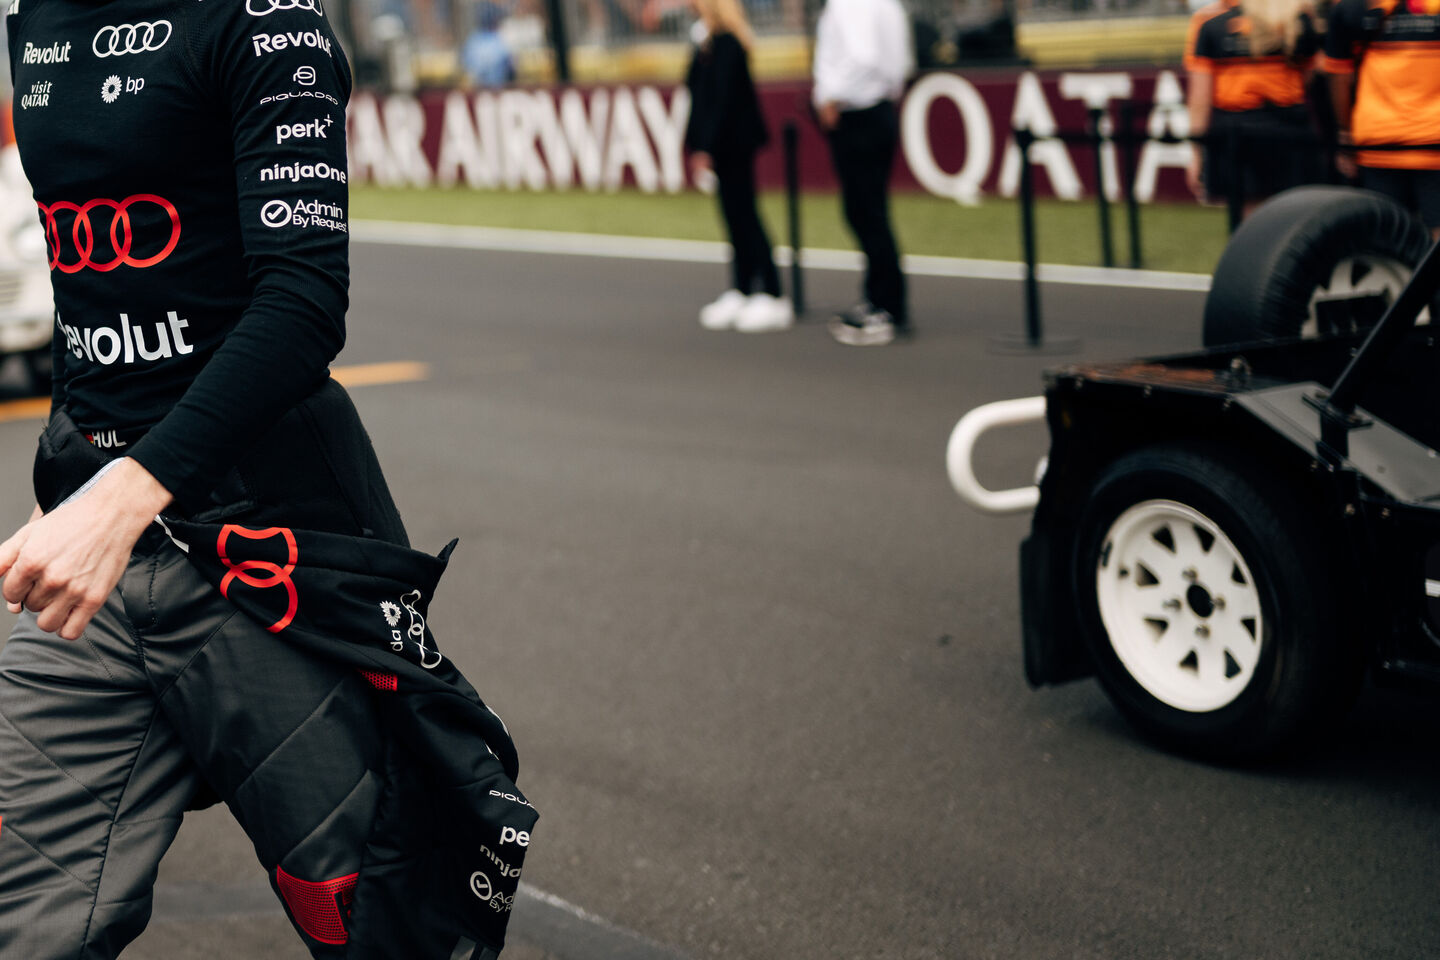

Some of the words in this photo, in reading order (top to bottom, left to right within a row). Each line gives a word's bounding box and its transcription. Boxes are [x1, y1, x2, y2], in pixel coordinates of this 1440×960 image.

[22, 41, 71, 64] Revolut
[31, 80, 53, 94] visit
[125, 76, 145, 95] bp
[21, 93, 50, 110] QATAR
[260, 91, 338, 105] PIQUADRO
[347, 93, 433, 189] AR
[436, 86, 691, 194] AIRWAY
[900, 71, 1192, 207] QATA
[260, 161, 347, 184] ninjaOne
[292, 199, 343, 219] Admin
[292, 214, 309, 228] By
[92, 429, 127, 448] HUL
[499, 826, 530, 847] pe
[479, 844, 522, 878] ninja
